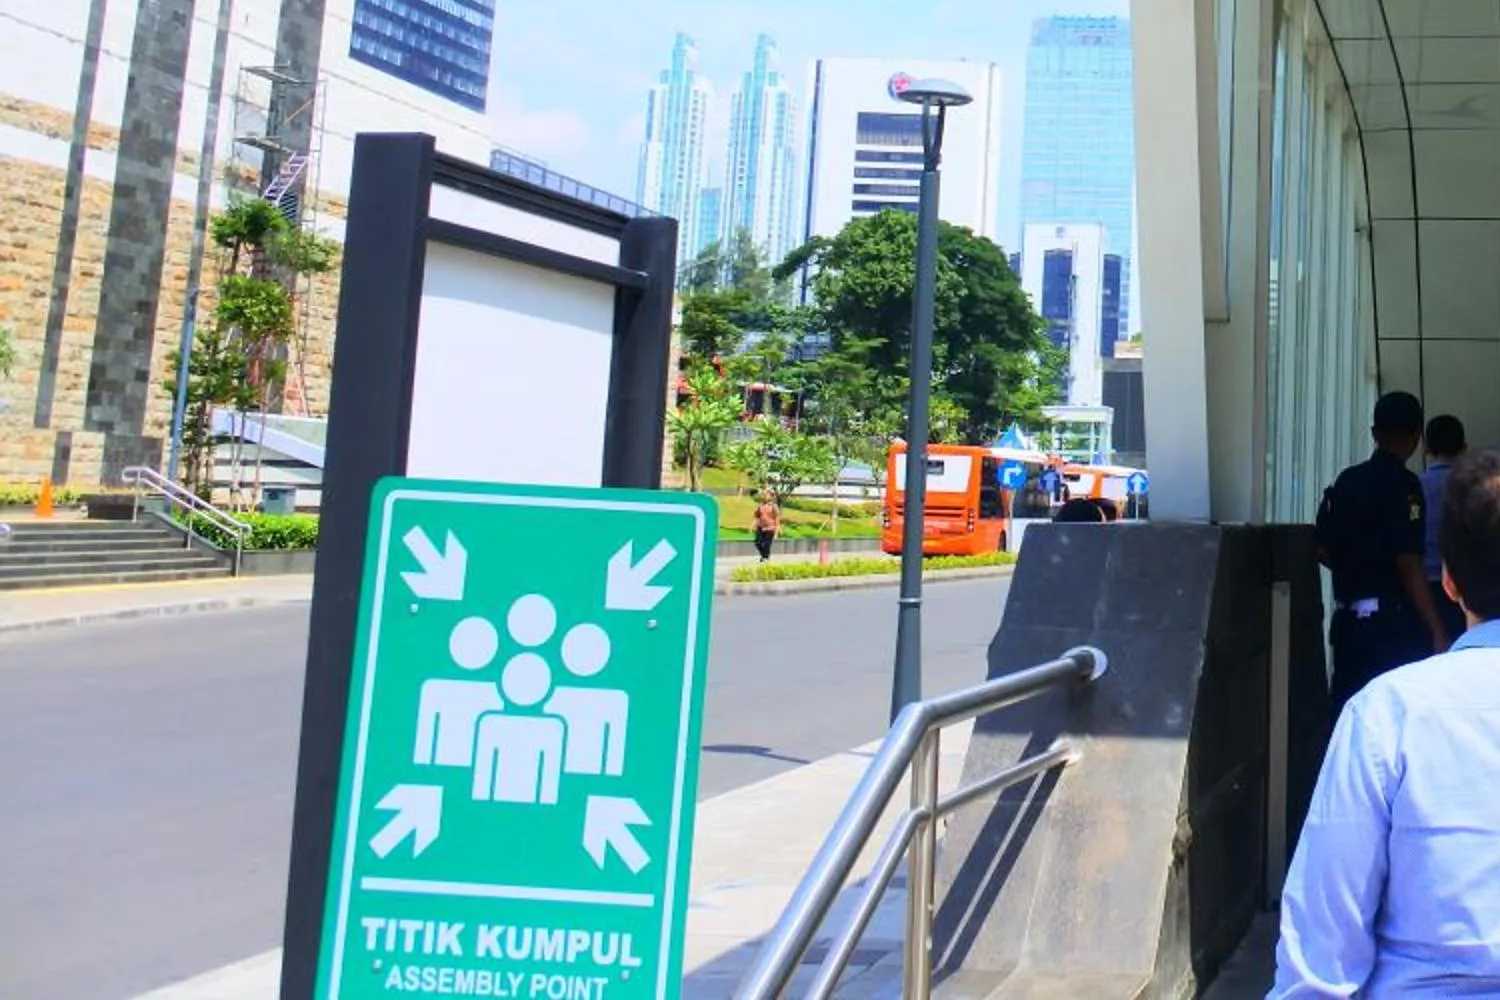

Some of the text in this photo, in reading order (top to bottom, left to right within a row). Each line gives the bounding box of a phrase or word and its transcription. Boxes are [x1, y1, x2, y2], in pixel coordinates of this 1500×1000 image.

[361, 916, 642, 967] TITIK KUMPUL
[384, 965, 609, 1000] ASSEMBLY POINT
